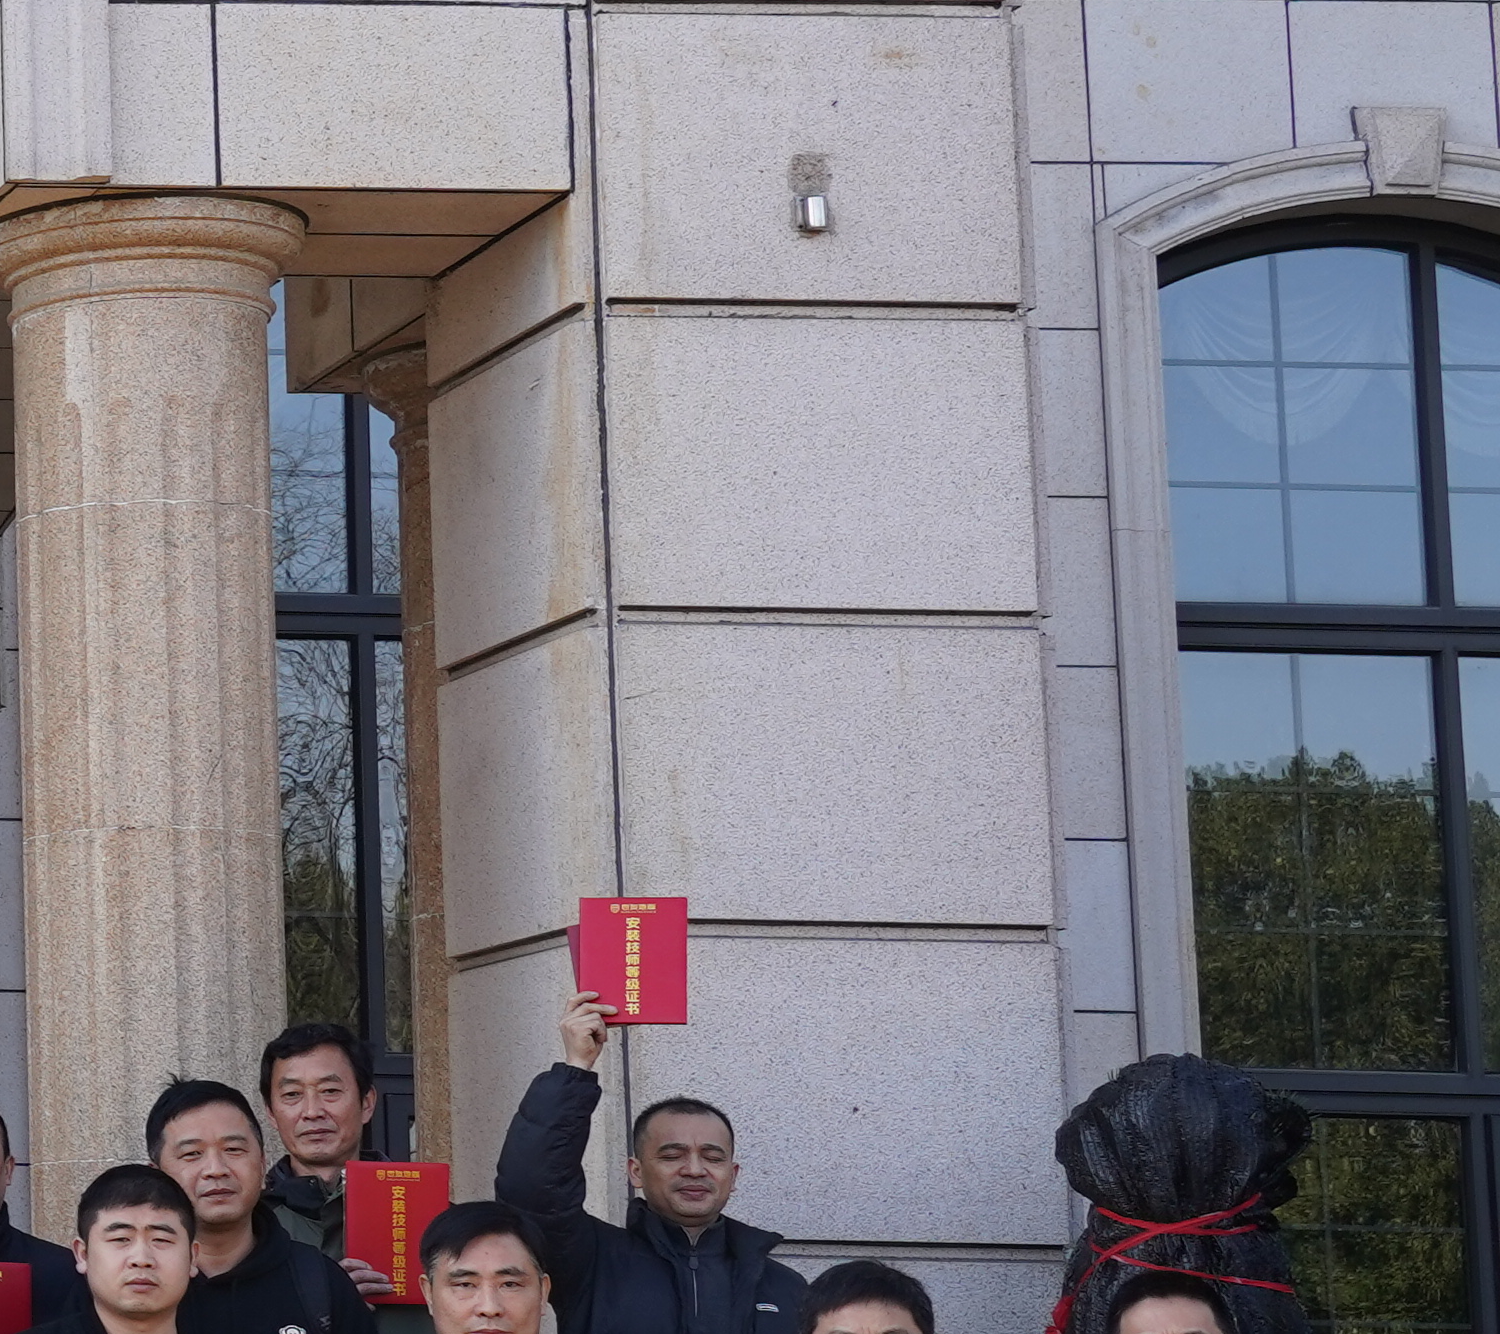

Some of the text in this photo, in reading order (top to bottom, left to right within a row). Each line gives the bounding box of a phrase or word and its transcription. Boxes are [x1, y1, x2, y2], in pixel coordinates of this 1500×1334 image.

[625, 917, 641, 1015] 安装技师等级证书
[391, 1185, 407, 1296] 安装技师等级证书
